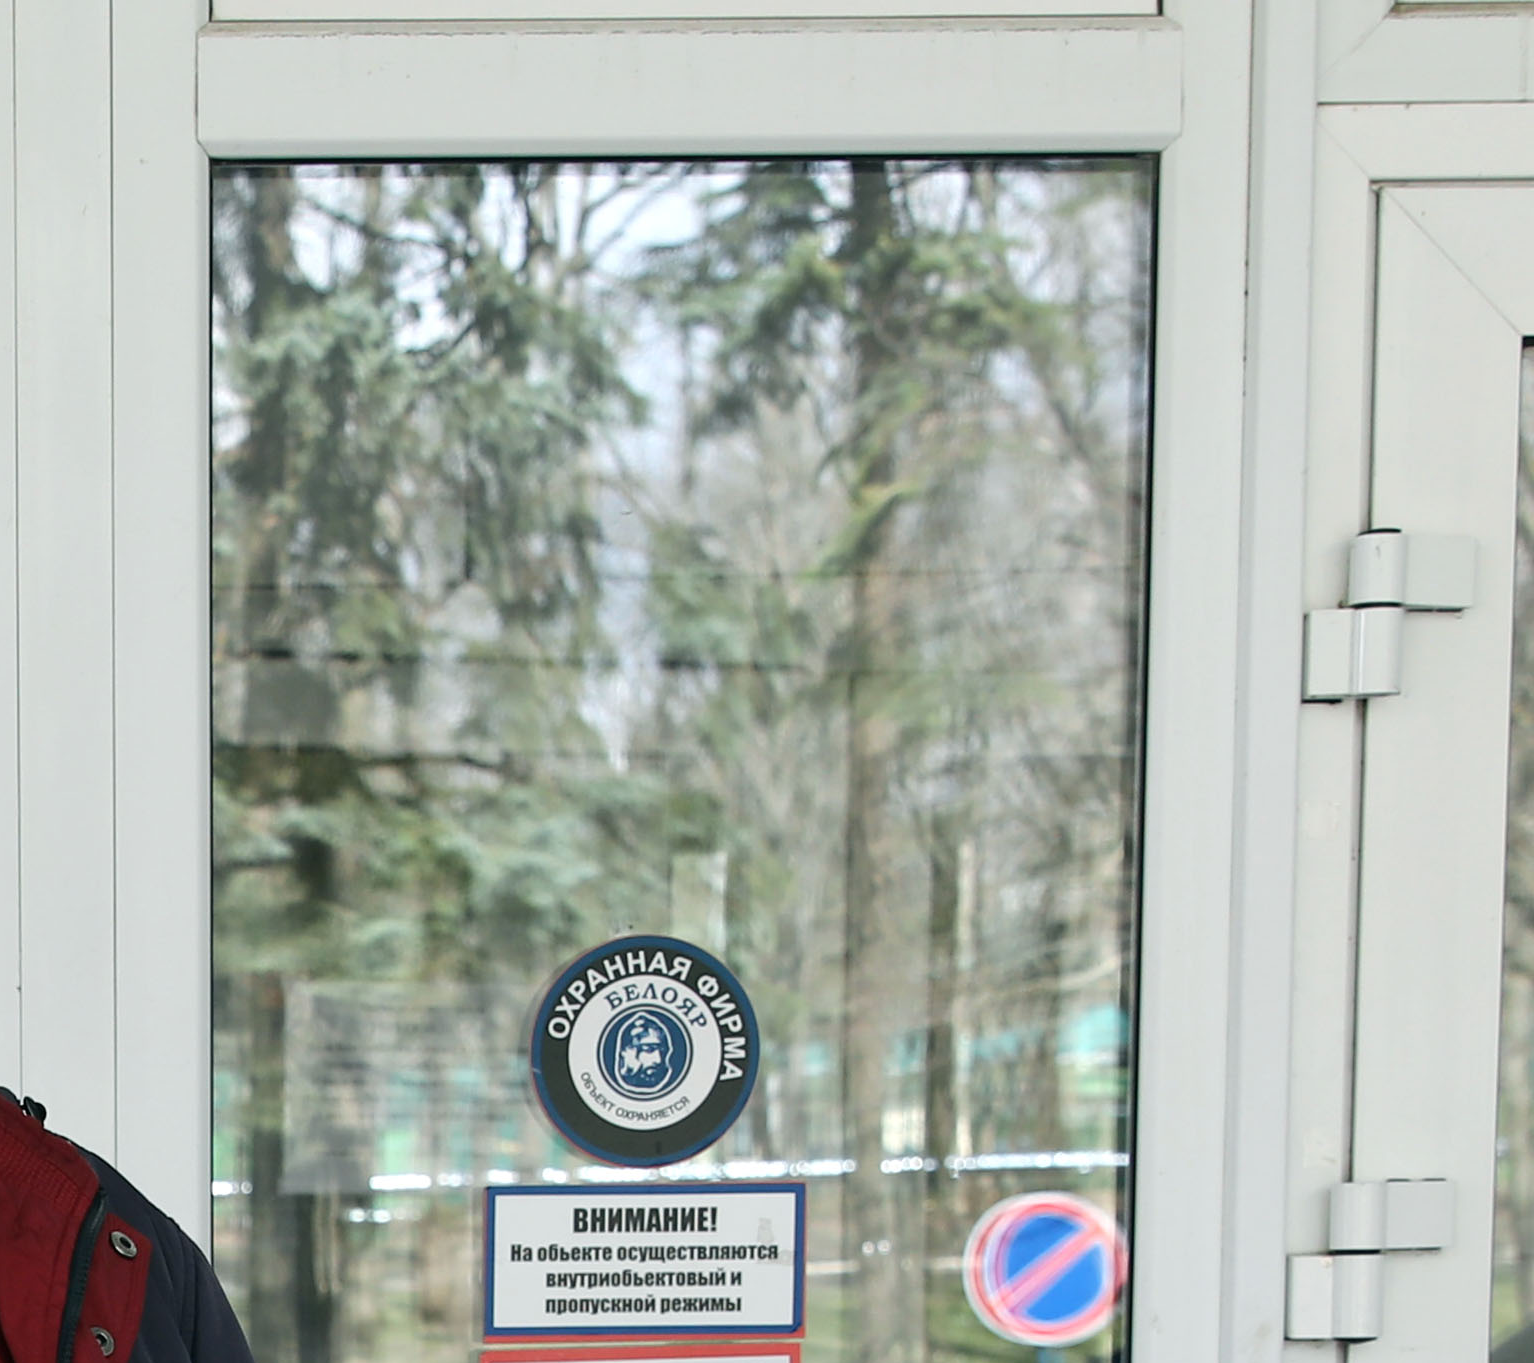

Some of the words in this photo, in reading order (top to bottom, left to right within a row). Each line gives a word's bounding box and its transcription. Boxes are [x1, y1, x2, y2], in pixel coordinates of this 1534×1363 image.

[548, 950, 693, 1039] ОХРАННАЯ
[697, 975, 747, 1081] ФИРМА
[604, 983, 707, 1030] БЕЛОЯР
[581, 1072, 616, 1112] ОБЪЕКТ
[615, 1096, 691, 1122] ОХРАНЯЕТСЯ
[572, 1206, 718, 1233] ВНИМАНИЕ!
[510, 1244, 533, 1262] На
[617, 1244, 778, 1263] осуществляются
[730, 1271, 742, 1286] и
[545, 1294, 656, 1315] пропускной
[660, 1296, 742, 1315] режимы
